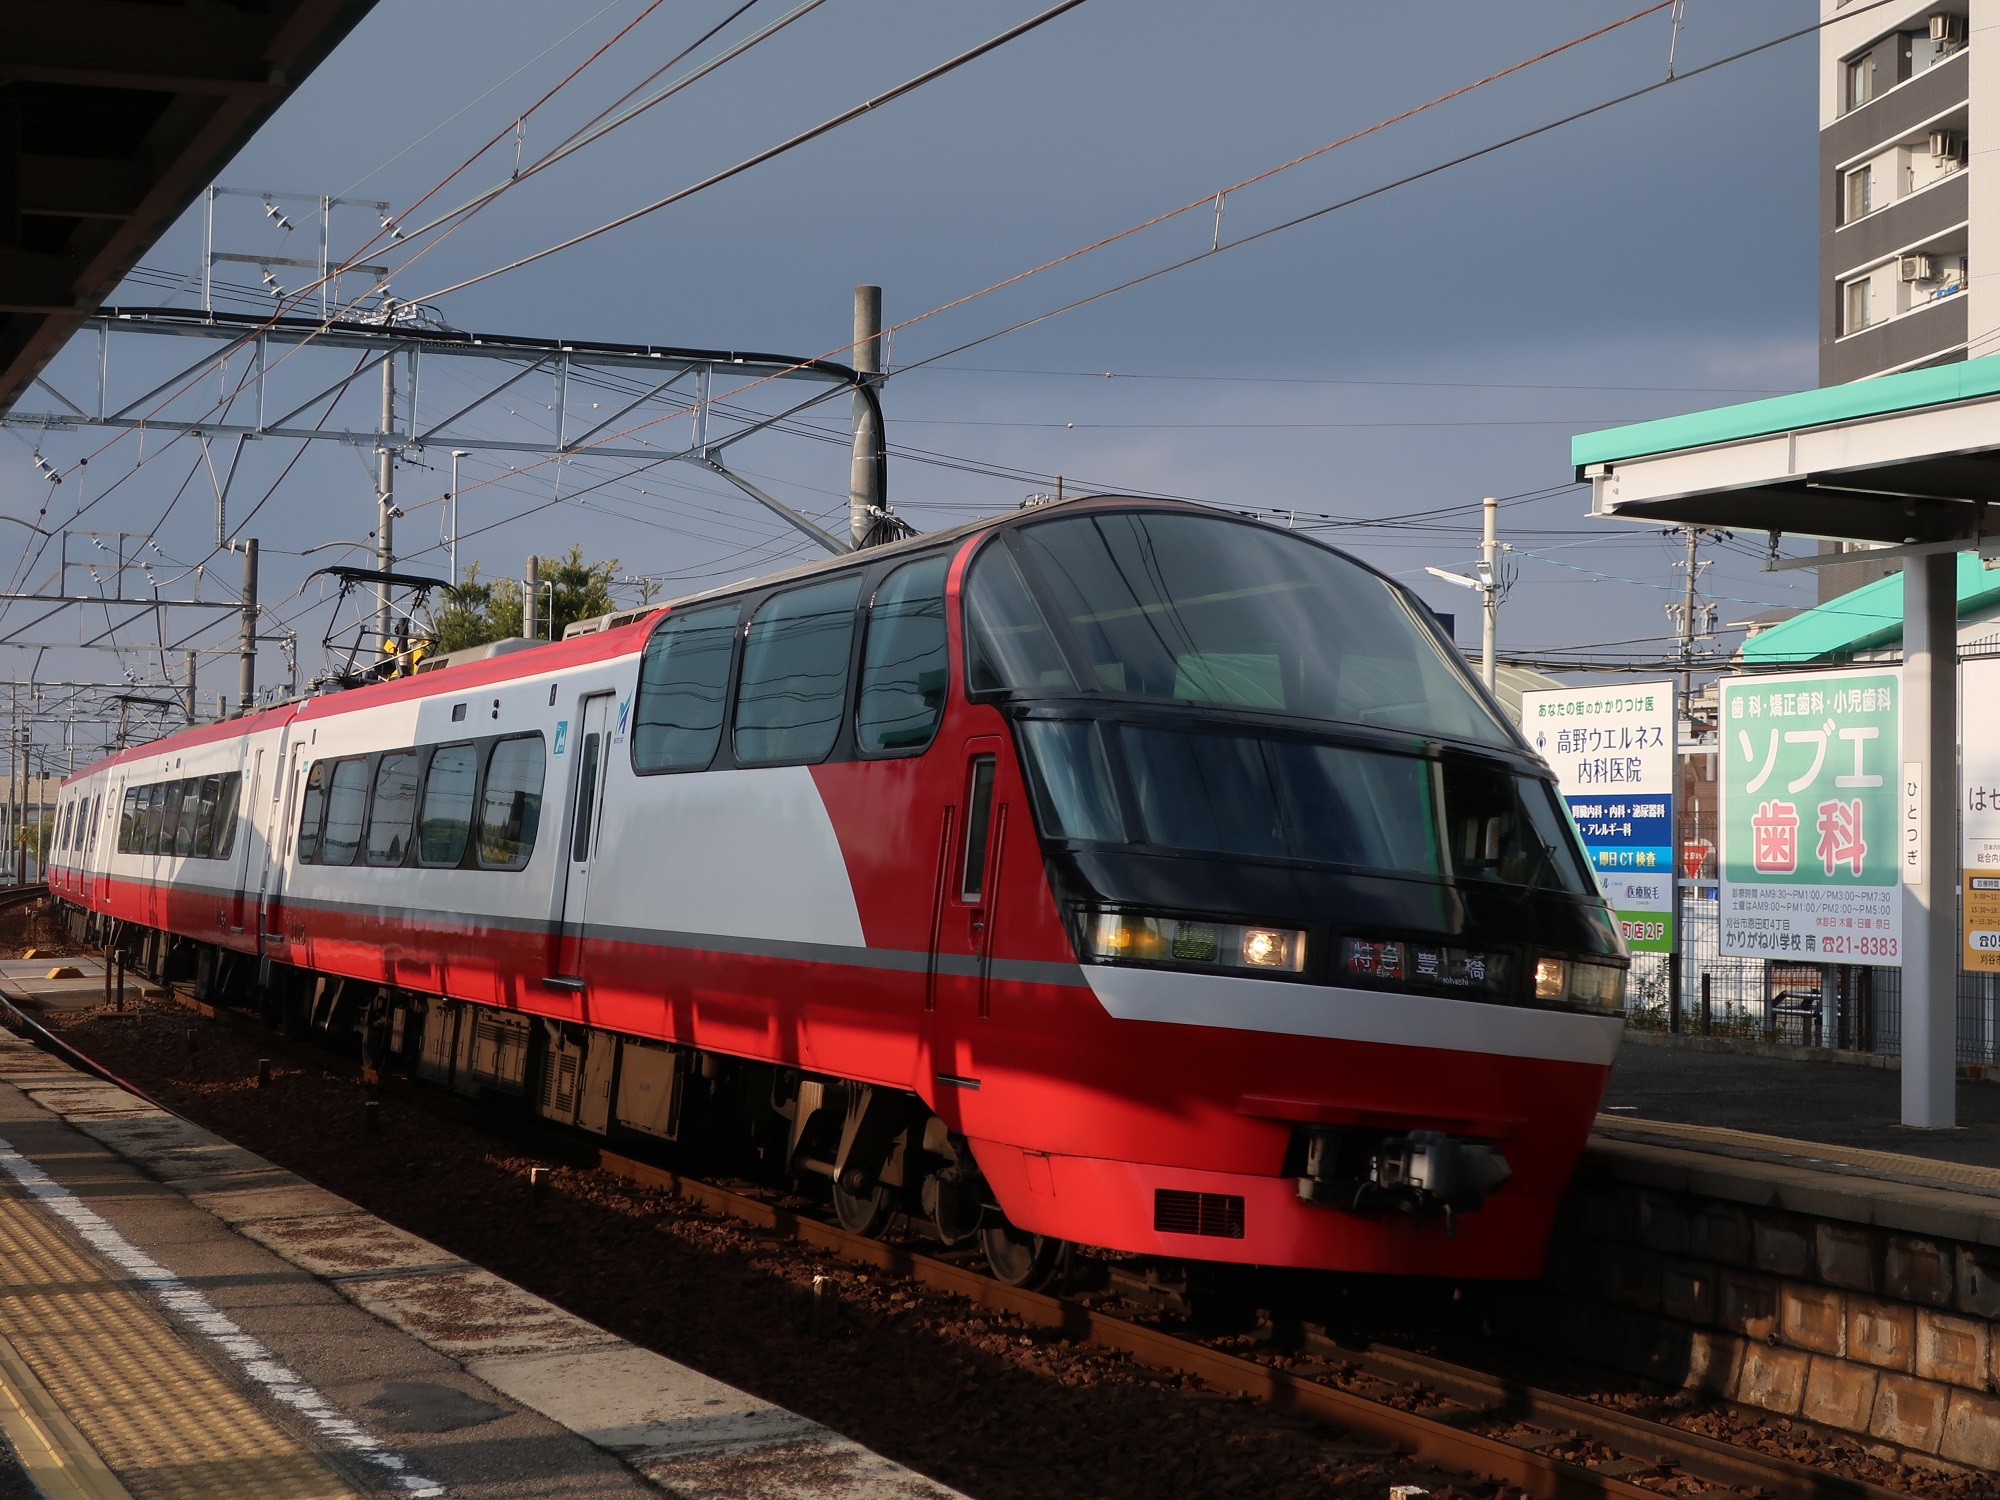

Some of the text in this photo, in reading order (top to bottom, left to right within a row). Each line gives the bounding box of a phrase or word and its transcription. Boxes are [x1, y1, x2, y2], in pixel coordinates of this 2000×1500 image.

[1538, 696, 1654, 717] あなたの街のかかりつけ医
[1557, 726, 1664, 754] 高野ウエルネス
[1578, 756, 1642, 784] 内科医院
[1739, 718, 1883, 794] ソブエ
[1906, 781, 1918, 865] ひとつぎ
[1751, 798, 1867, 877] 歯科
[1627, 885, 1660, 900] 医療脱毛
[1815, 917, 1837, 928] 休診日
[1725, 930, 1817, 952] かりがね小学校 南
